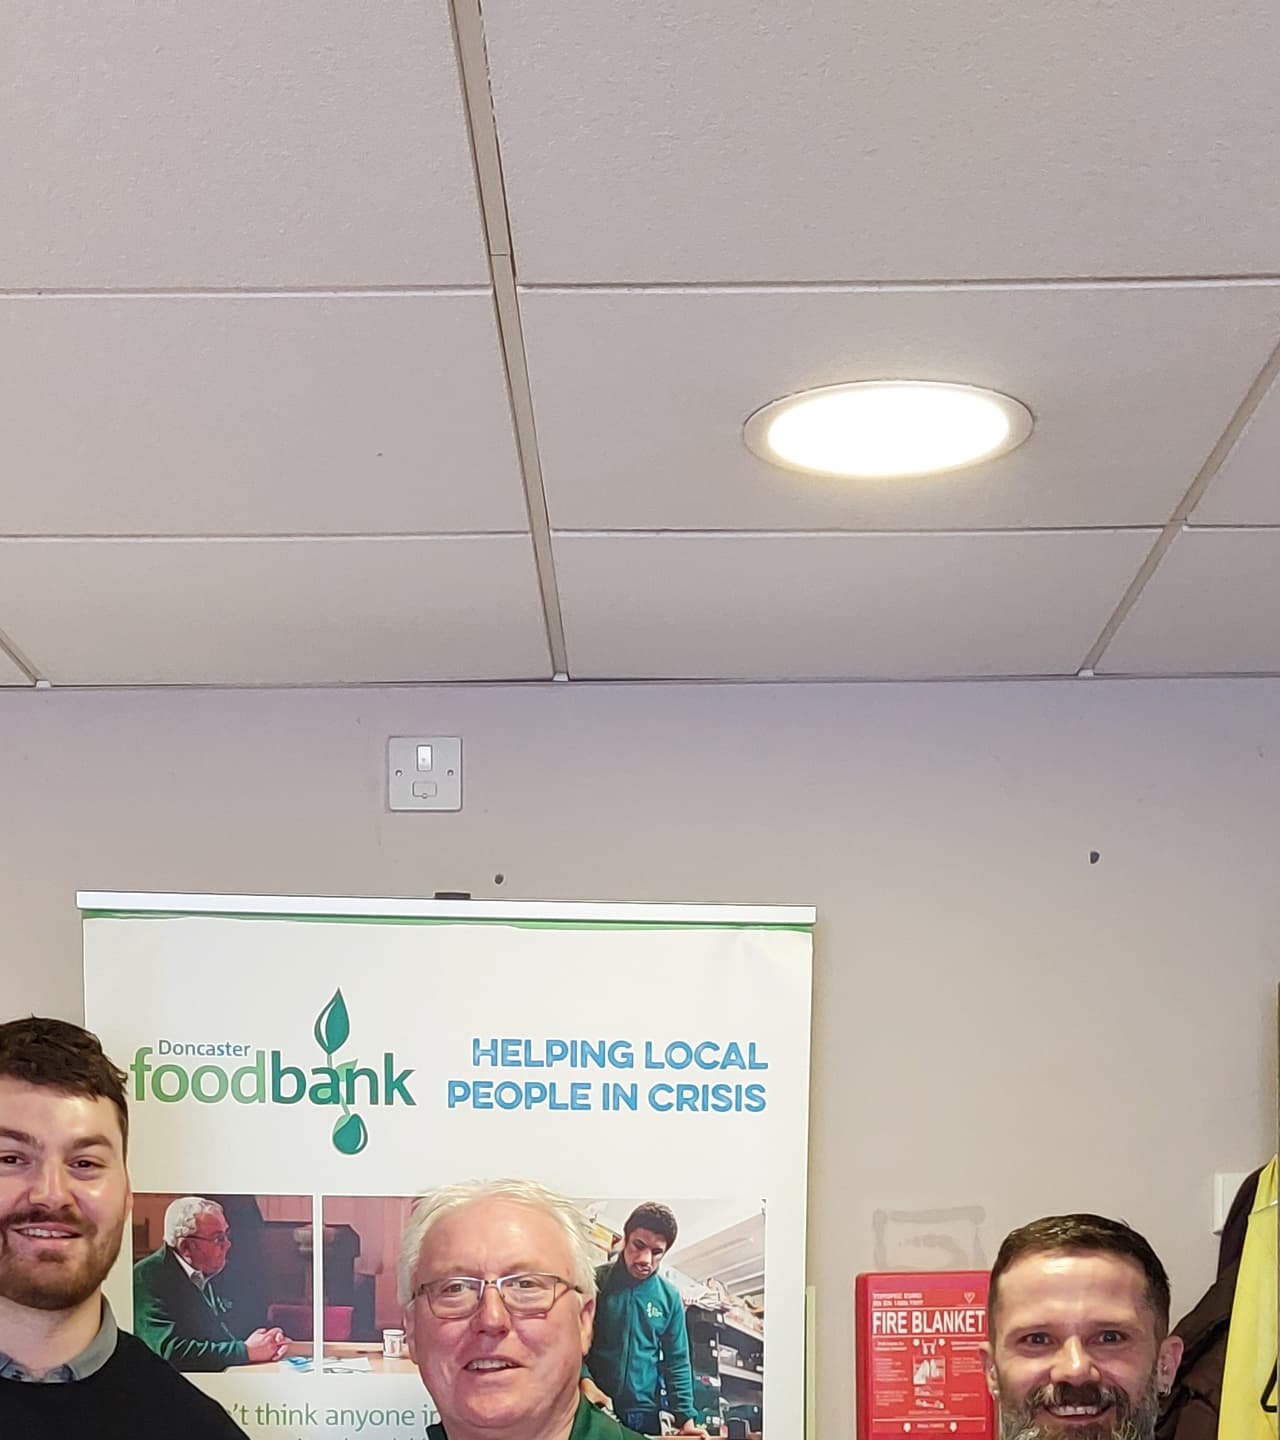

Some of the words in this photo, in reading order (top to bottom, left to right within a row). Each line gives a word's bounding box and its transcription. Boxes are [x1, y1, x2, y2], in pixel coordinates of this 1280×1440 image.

[158, 1040, 251, 1059] Doncaster
[473, 1038, 633, 1069] HELPING
[645, 1040, 769, 1071] LOCAL
[131, 1046, 416, 1106] foodbank
[448, 1082, 592, 1112] PEOPLE
[601, 1084, 637, 1112] IN
[647, 1084, 767, 1113] CRISIS
[873, 1311, 908, 1334] FIRE
[912, 1311, 986, 1333] BLANKET
[255, 1404, 318, 1426] think
[325, 1407, 416, 1431] anyone
